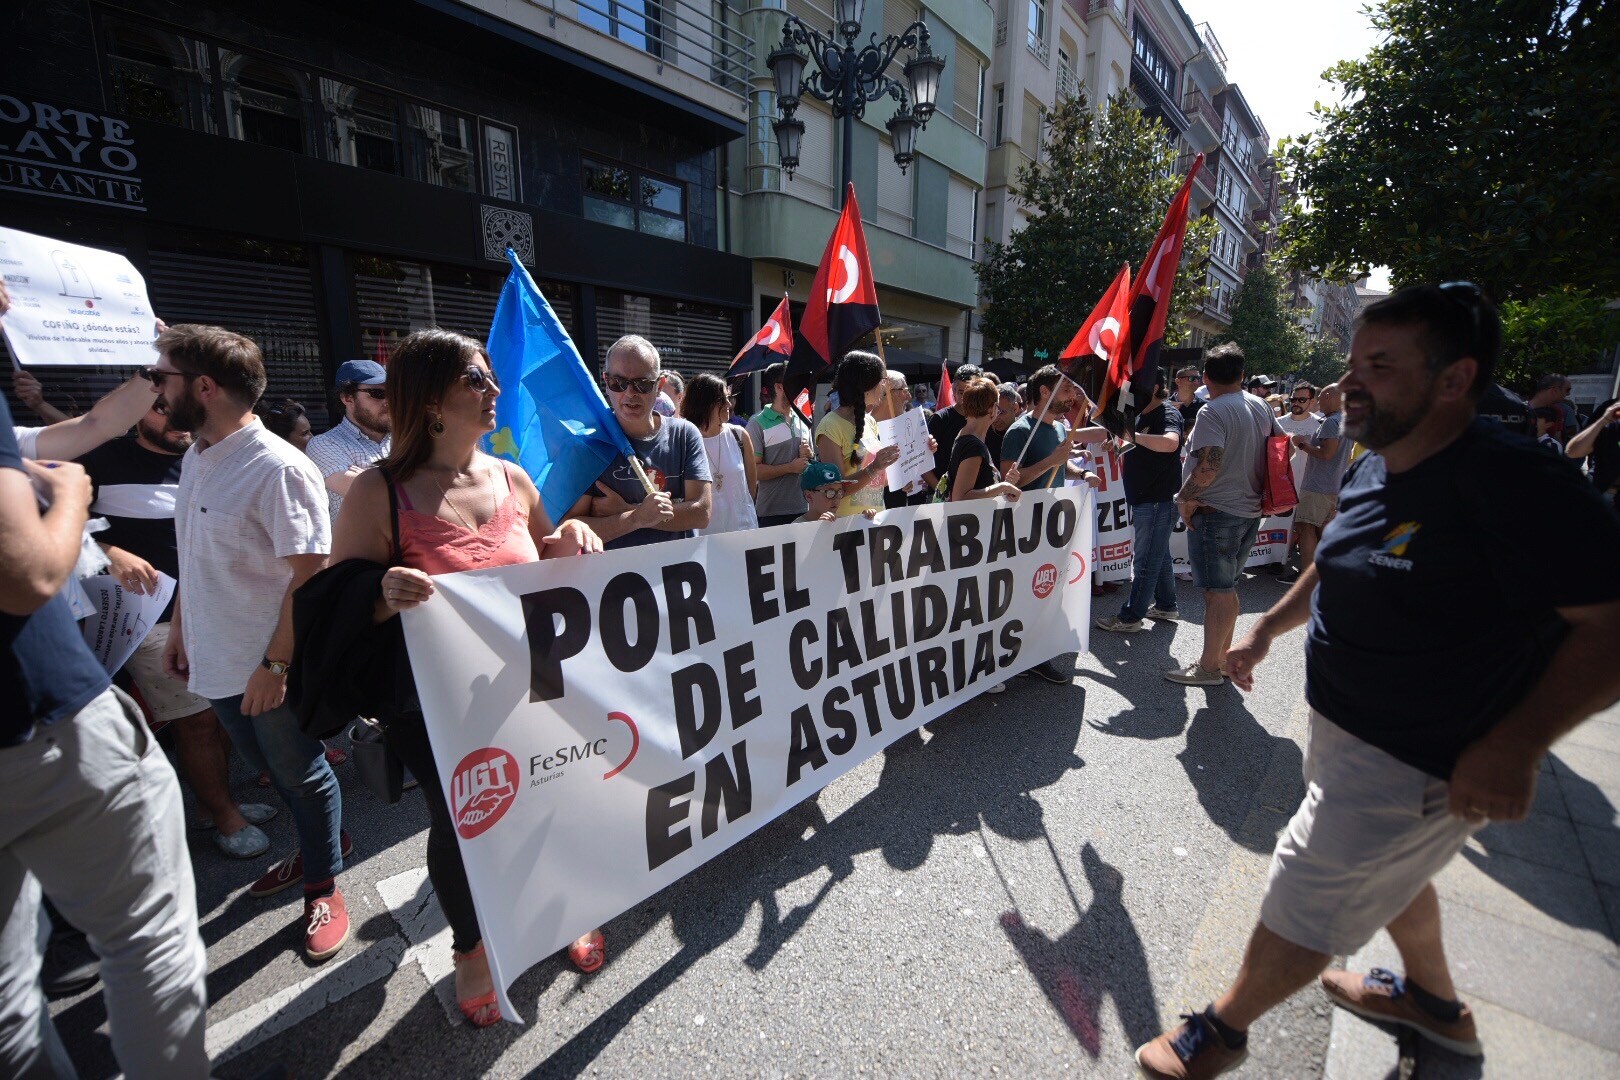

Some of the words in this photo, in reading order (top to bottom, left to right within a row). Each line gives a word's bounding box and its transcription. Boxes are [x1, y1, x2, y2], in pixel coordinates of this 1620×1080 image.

[0, 94, 135, 145] ORTE
[492, 139, 509, 200] RESTAU
[42, 319, 80, 331] COFIÑO
[82, 320, 113, 333] ¿dónde
[115, 323, 141, 334] estás?
[1036, 568, 1056, 583] UGT
[101, 589, 109, 621] DESIERTO
[520, 561, 716, 703] POR
[744, 541, 811, 625] EL
[832, 498, 1077, 594] TRABAJO
[95, 621, 107, 652] LABORAL
[671, 641, 762, 760] DE
[789, 568, 1014, 690] CALIDAD
[529, 737, 608, 777] FeSMC
[646, 739, 752, 872] EN
[786, 619, 1024, 787] ASTURIAS
[454, 754, 511, 799] UGT
[529, 769, 565, 789] Asturias
